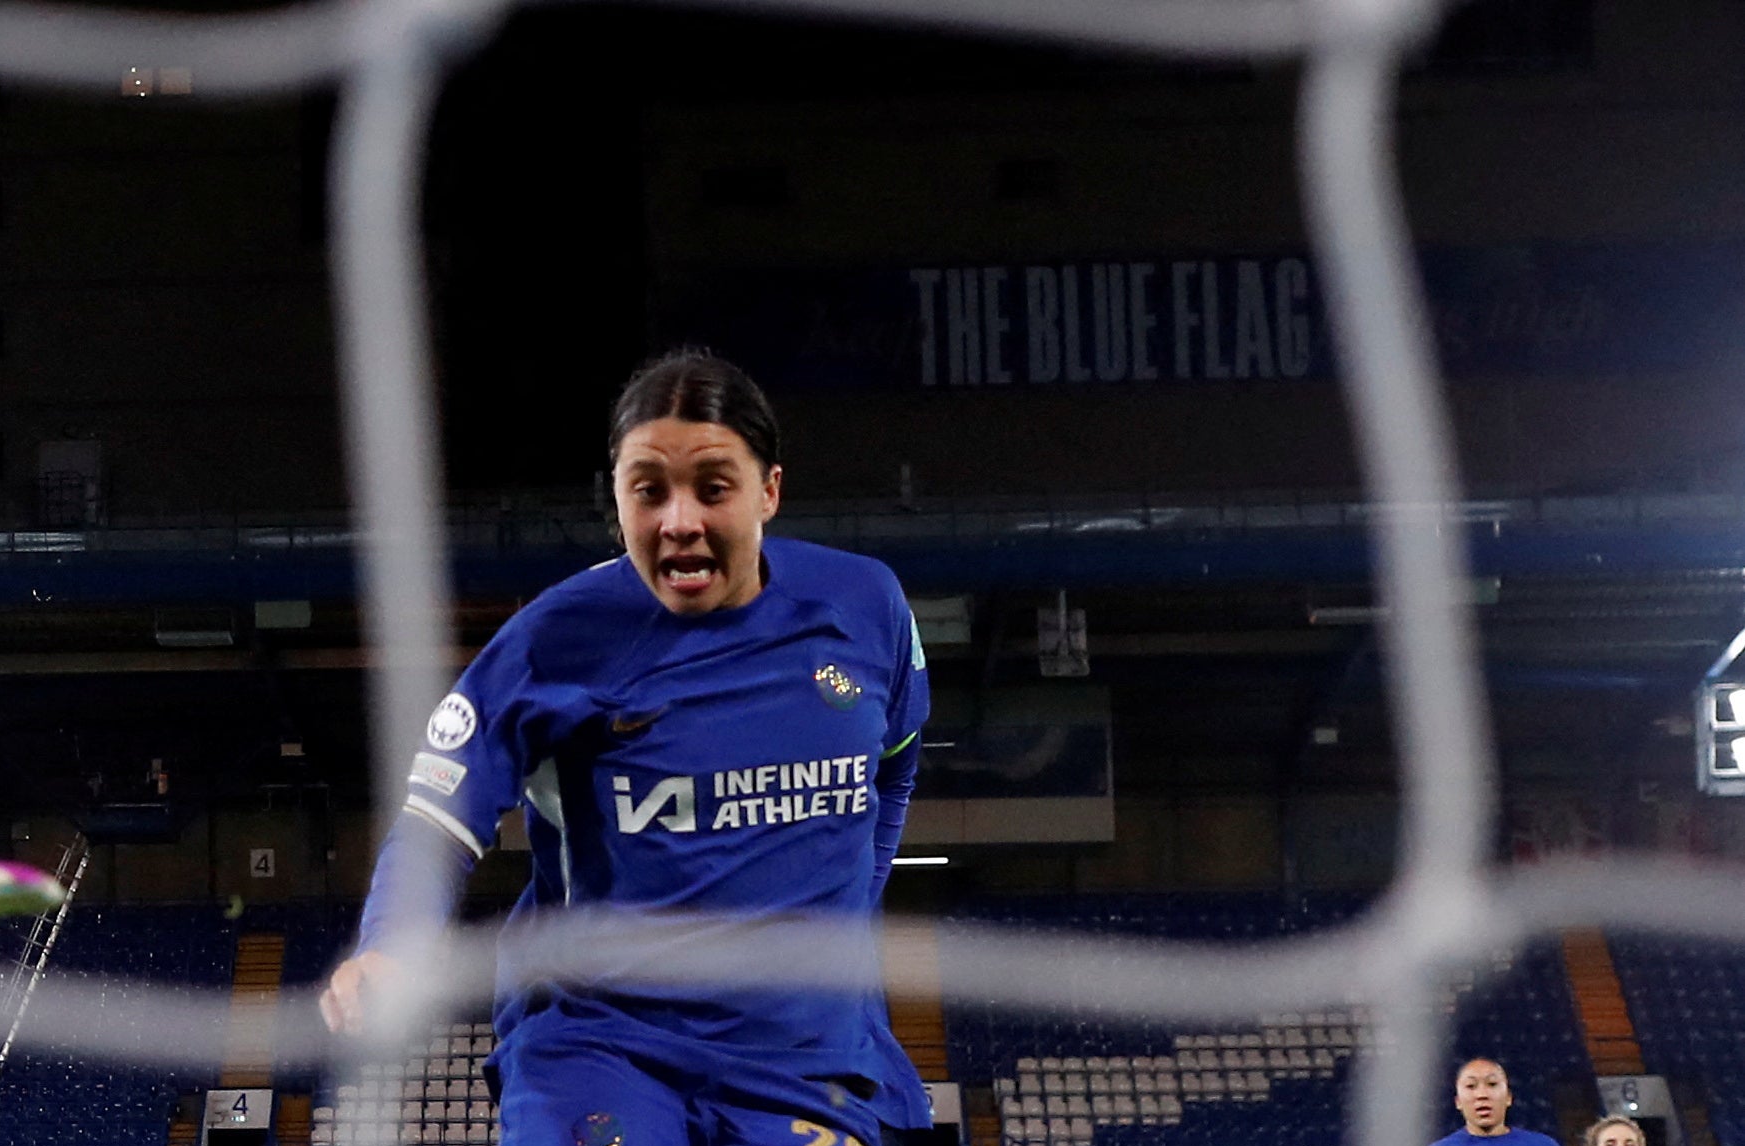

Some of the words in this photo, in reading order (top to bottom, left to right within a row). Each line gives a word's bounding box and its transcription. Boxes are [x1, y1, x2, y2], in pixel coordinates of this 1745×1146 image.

[909, 267, 1013, 386] THE
[1024, 261, 1159, 384] BLUE
[1171, 257, 1313, 382] FLAG
[714, 754, 868, 798] INFINITE
[711, 785, 868, 831] ATHLETE
[255, 854, 270, 873] 4
[232, 1093, 248, 1115] 4
